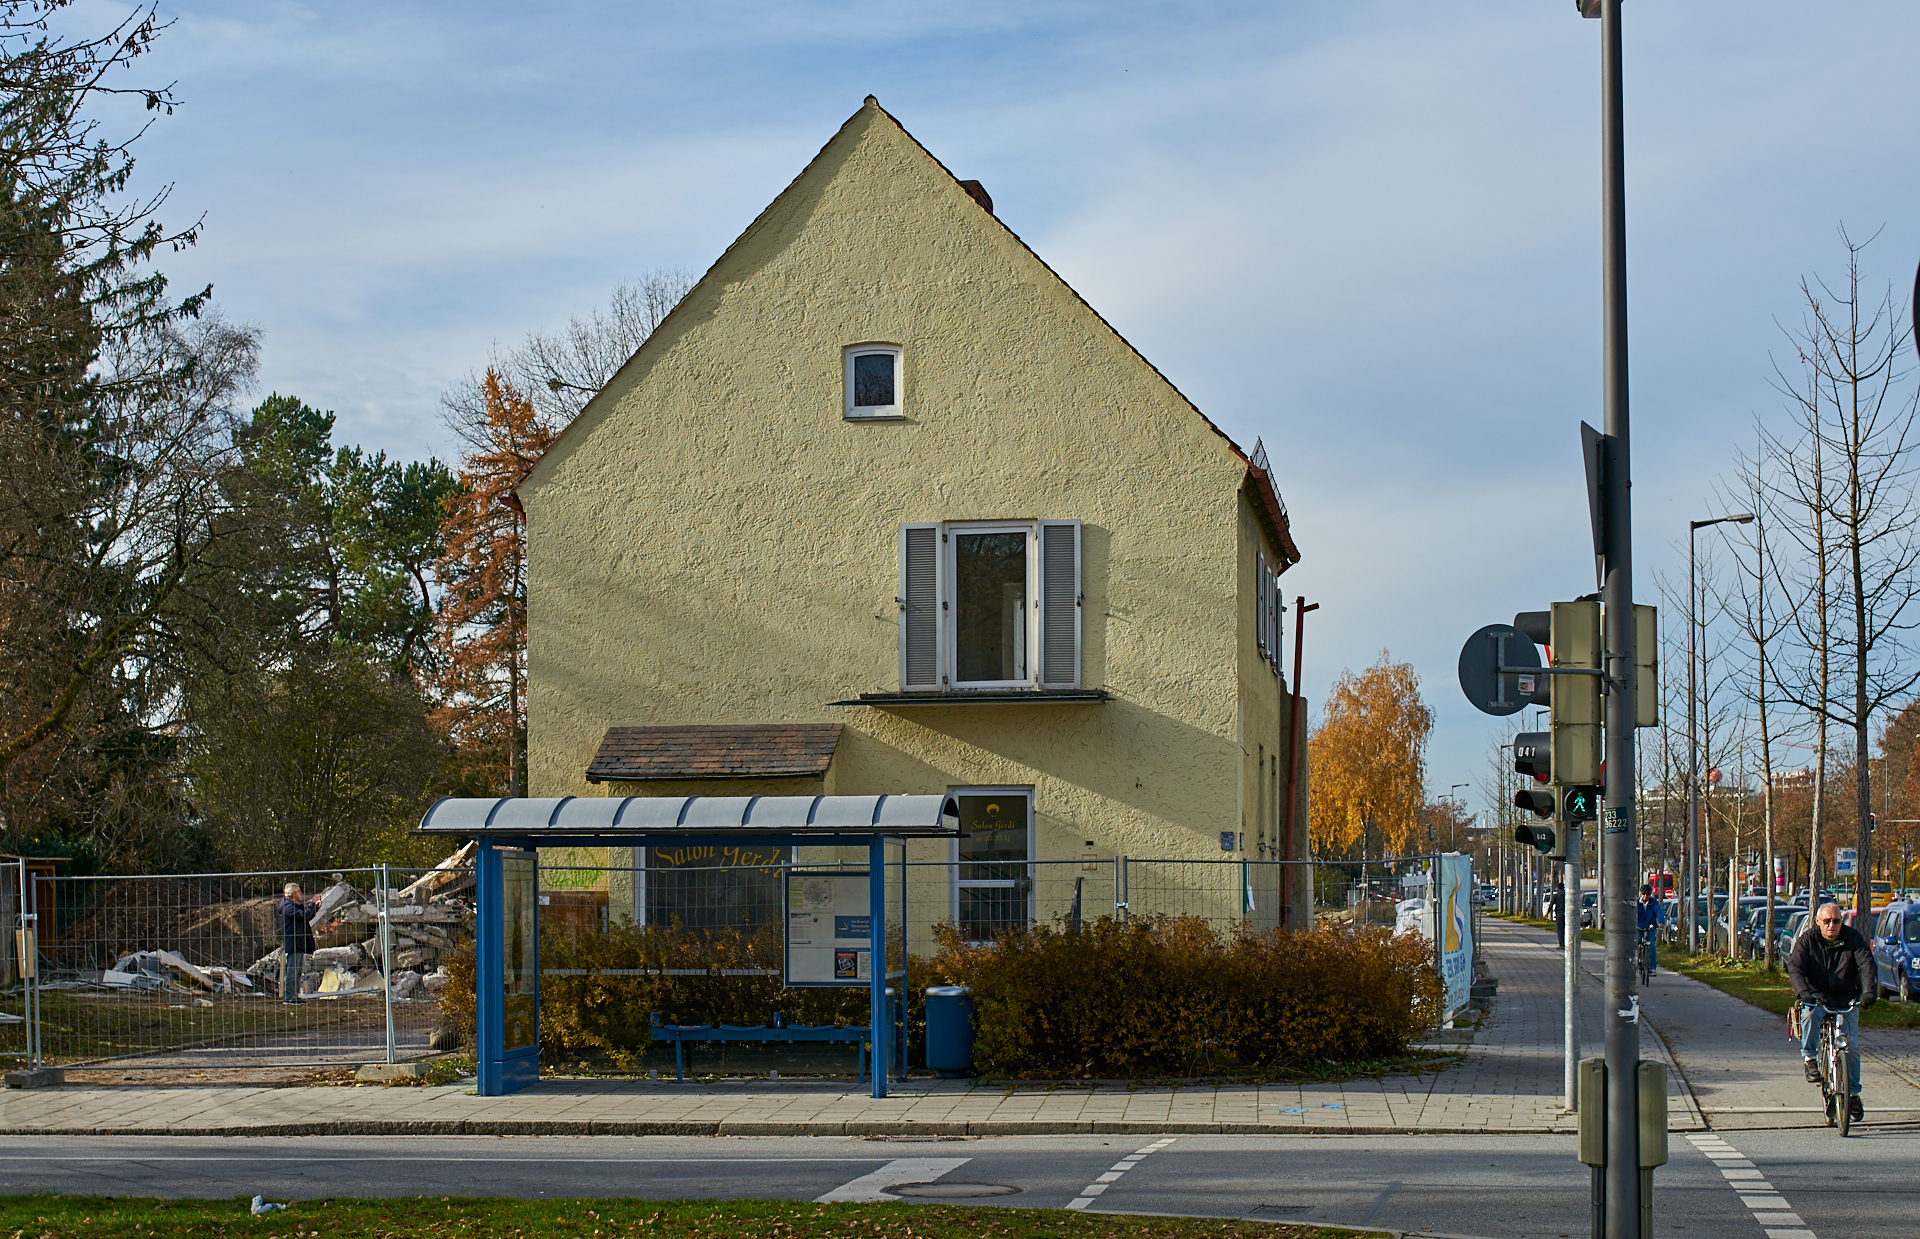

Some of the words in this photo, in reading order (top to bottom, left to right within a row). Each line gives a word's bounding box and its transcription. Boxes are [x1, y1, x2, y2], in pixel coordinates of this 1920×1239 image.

[1518, 746, 1536, 757] 041
[971, 820, 992, 829] Salon
[994, 820, 1015, 831] Gerdi
[655, 846, 716, 873] Salon
